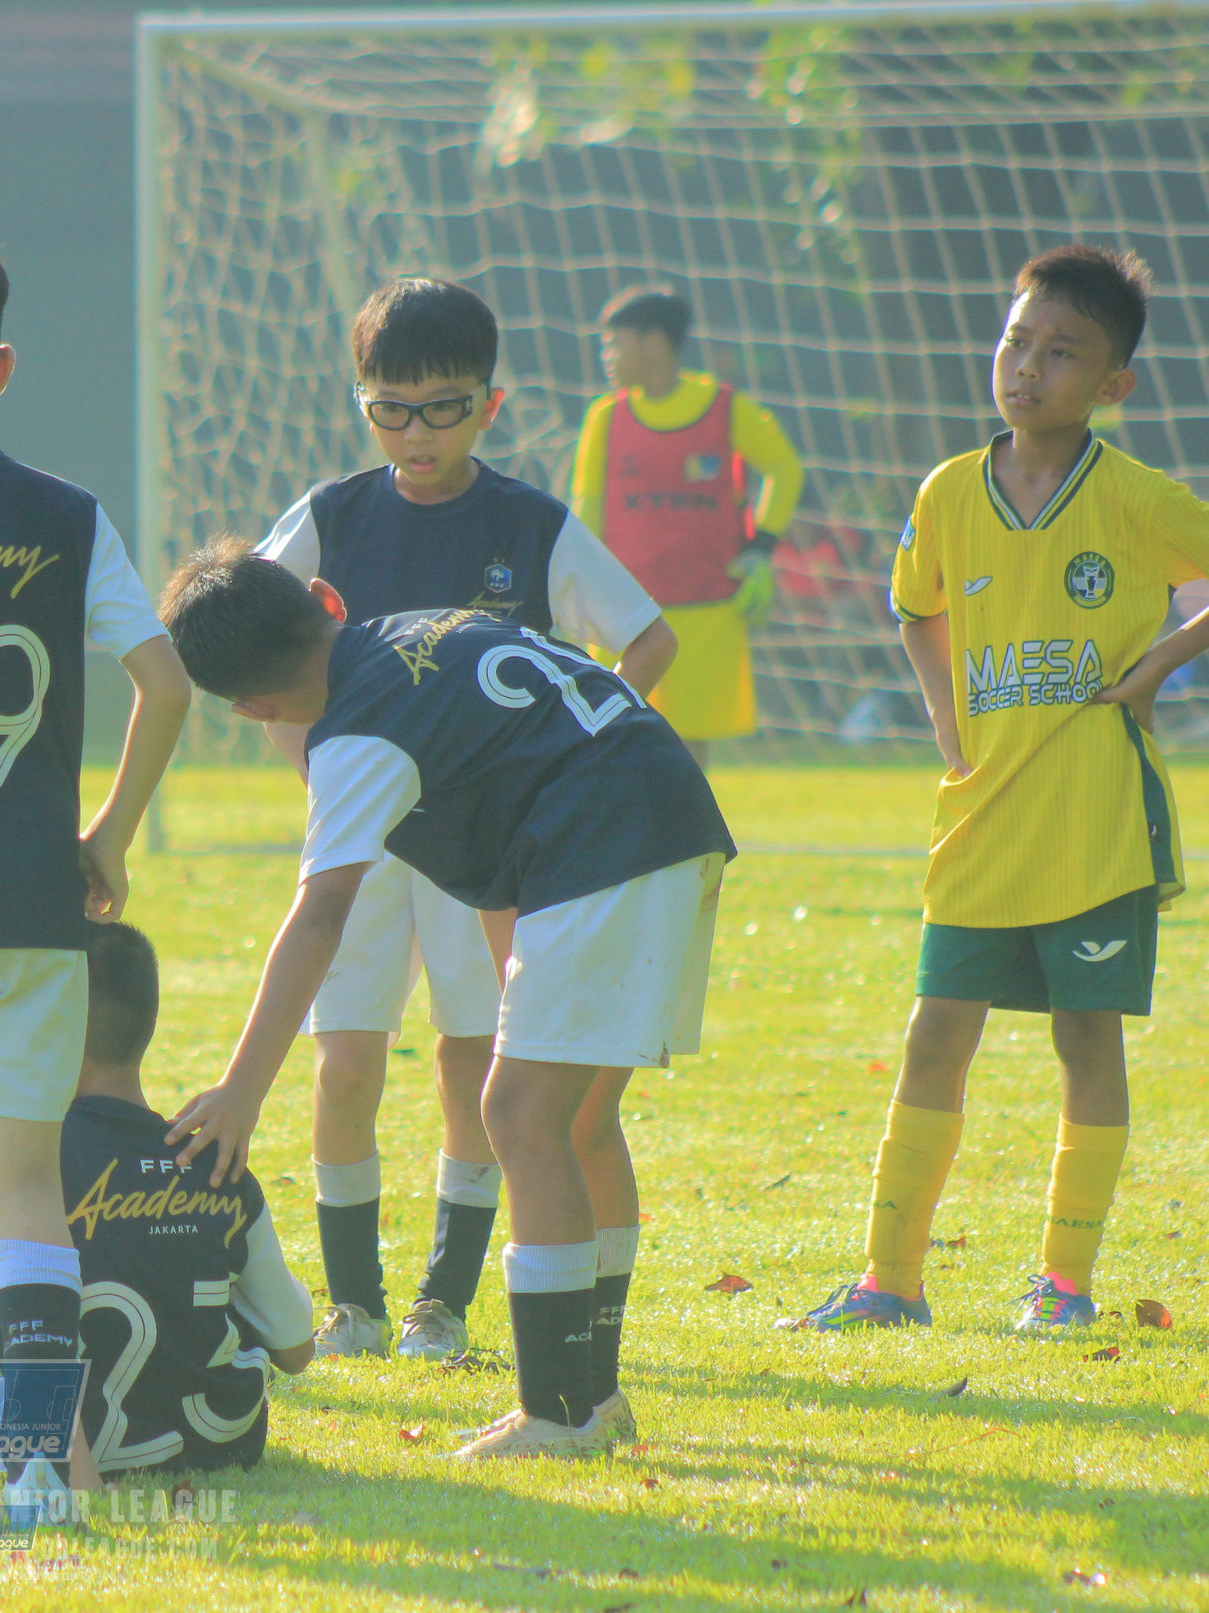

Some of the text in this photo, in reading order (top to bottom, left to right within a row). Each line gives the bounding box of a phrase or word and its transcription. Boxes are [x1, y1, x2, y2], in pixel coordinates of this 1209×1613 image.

[964, 638, 1103, 693] MAESA
[967, 680, 1103, 717] SOCCER SCHOO
[67, 1158, 248, 1249] Academy
[149, 1225, 199, 1235] JAKARTA
[78, 1272, 271, 1474] 23
